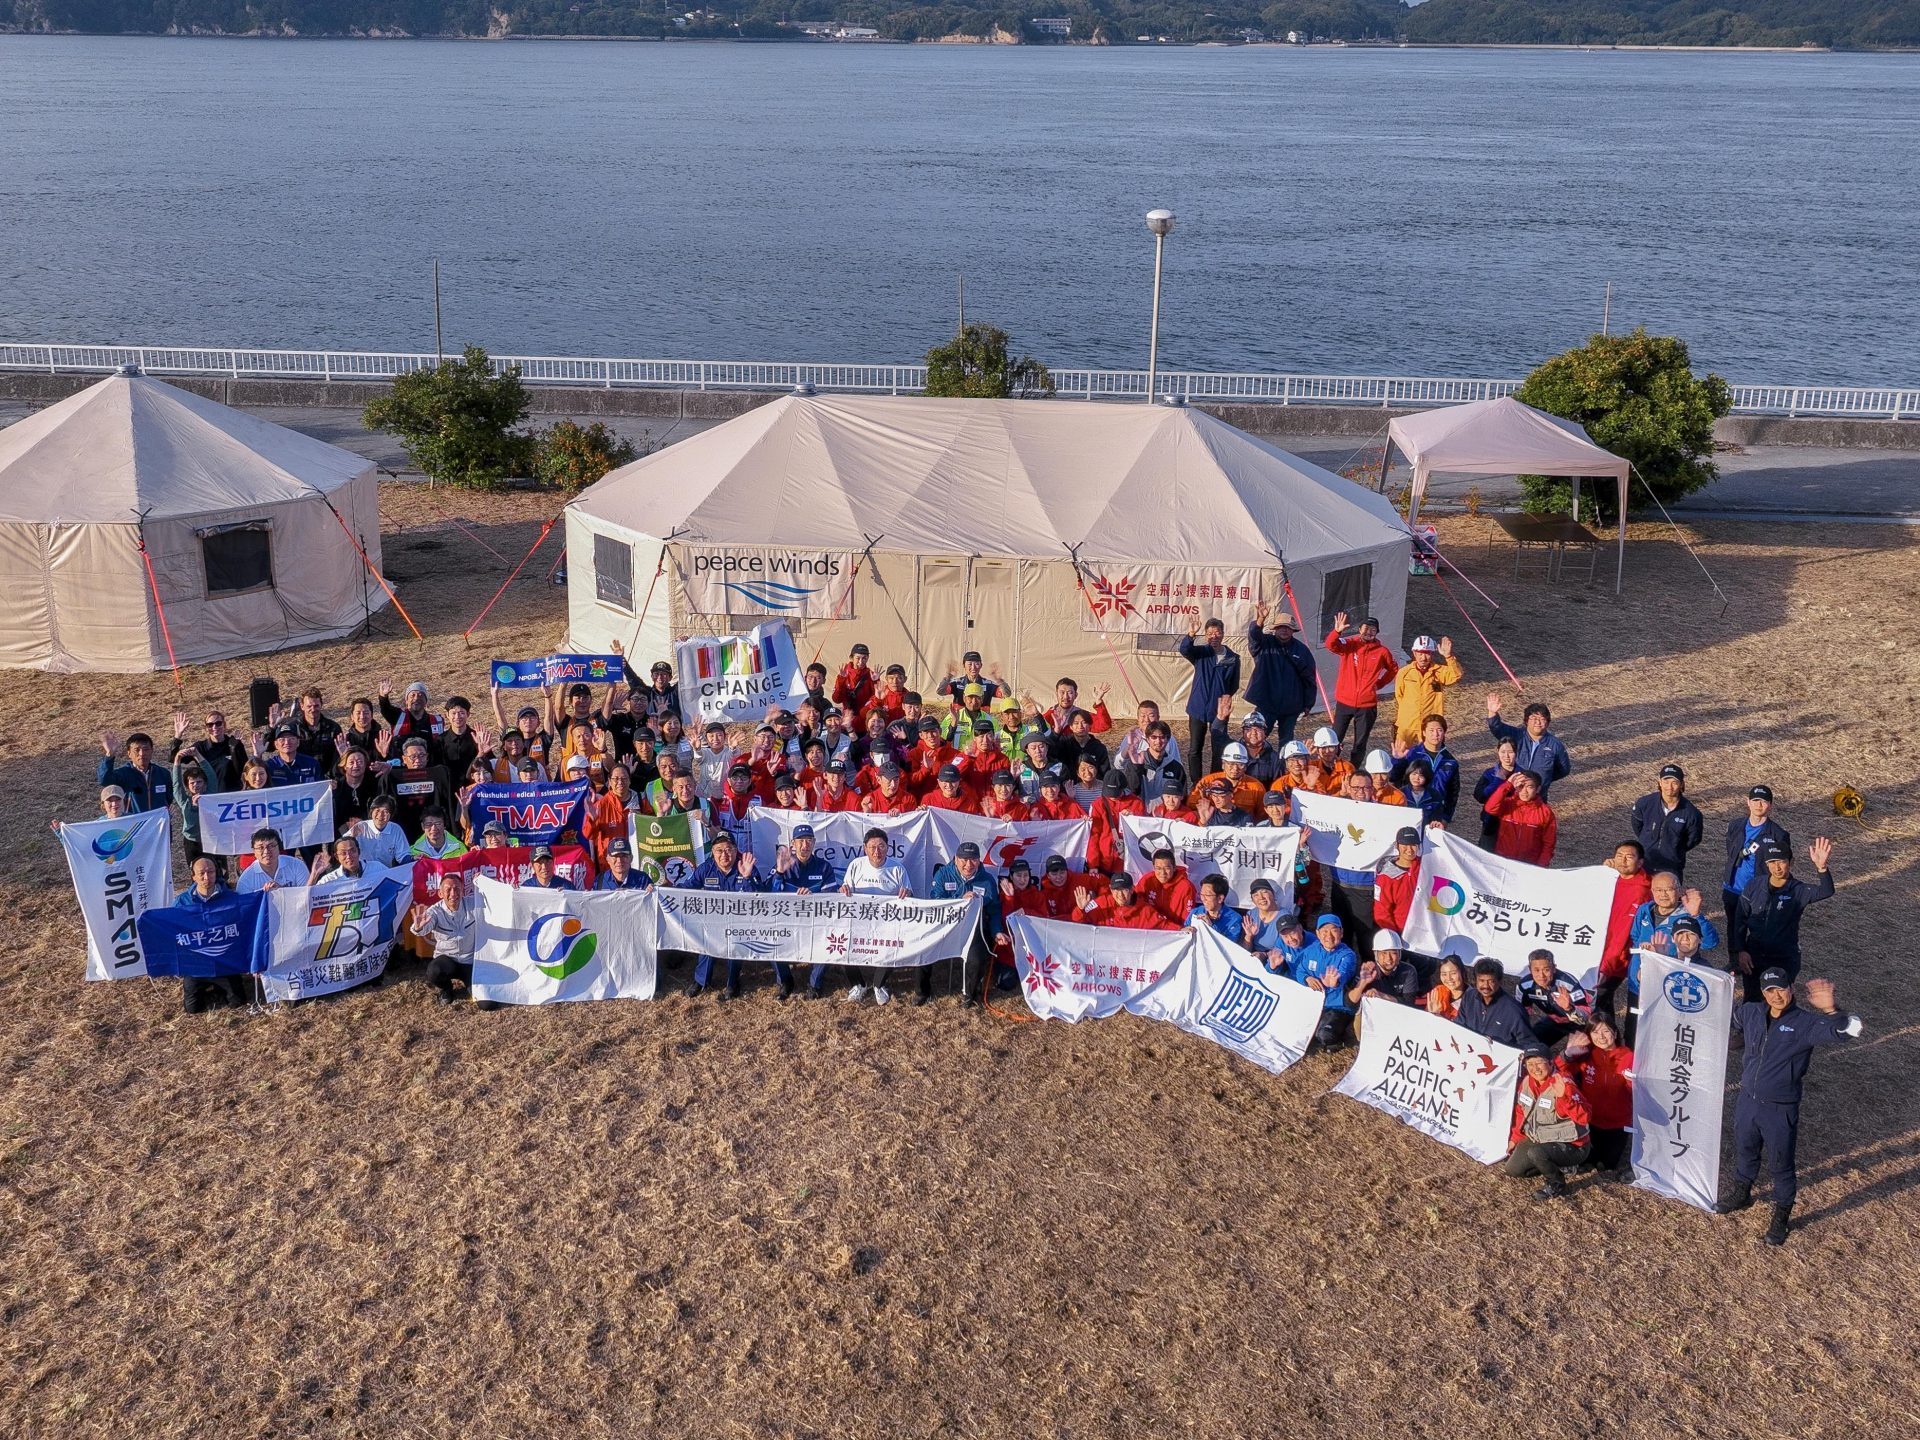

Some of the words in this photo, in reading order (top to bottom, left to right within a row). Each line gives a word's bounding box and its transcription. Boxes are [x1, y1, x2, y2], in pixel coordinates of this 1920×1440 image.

[694, 555, 763, 576] peace
[769, 553, 840, 576] winds
[1146, 582, 1250, 600] 空飛ぶ捜索医療団
[1145, 604, 1199, 614] ARROWS
[701, 672, 783, 697] CHANGE
[703, 691, 788, 711] HOLDINGS
[486, 800, 576, 830] TMAT
[653, 844, 691, 852] ASSOCIATION
[1181, 836, 1247, 849] 公益財団法人
[1182, 848, 1283, 873] トヨタ財団
[661, 894, 967, 925] 多機関連携災害時医療救助訓練
[1473, 891, 1552, 917] 大東建託グループ
[104, 871, 141, 969] SMAS
[725, 926, 757, 938] peace
[759, 928, 791, 938] winds
[1466, 902, 1595, 947] みらい基金
[175, 923, 240, 946] 和平之風
[1072, 981, 1122, 996] ARROWS
[1389, 1035, 1430, 1066] ASIA
[1383, 1056, 1451, 1098] PACIFIC
[1366, 1091, 1382, 1102] FOR
[1372, 1078, 1460, 1128] ALLIANCE
[1669, 1023, 1695, 1158] 伯鳳会グループ
